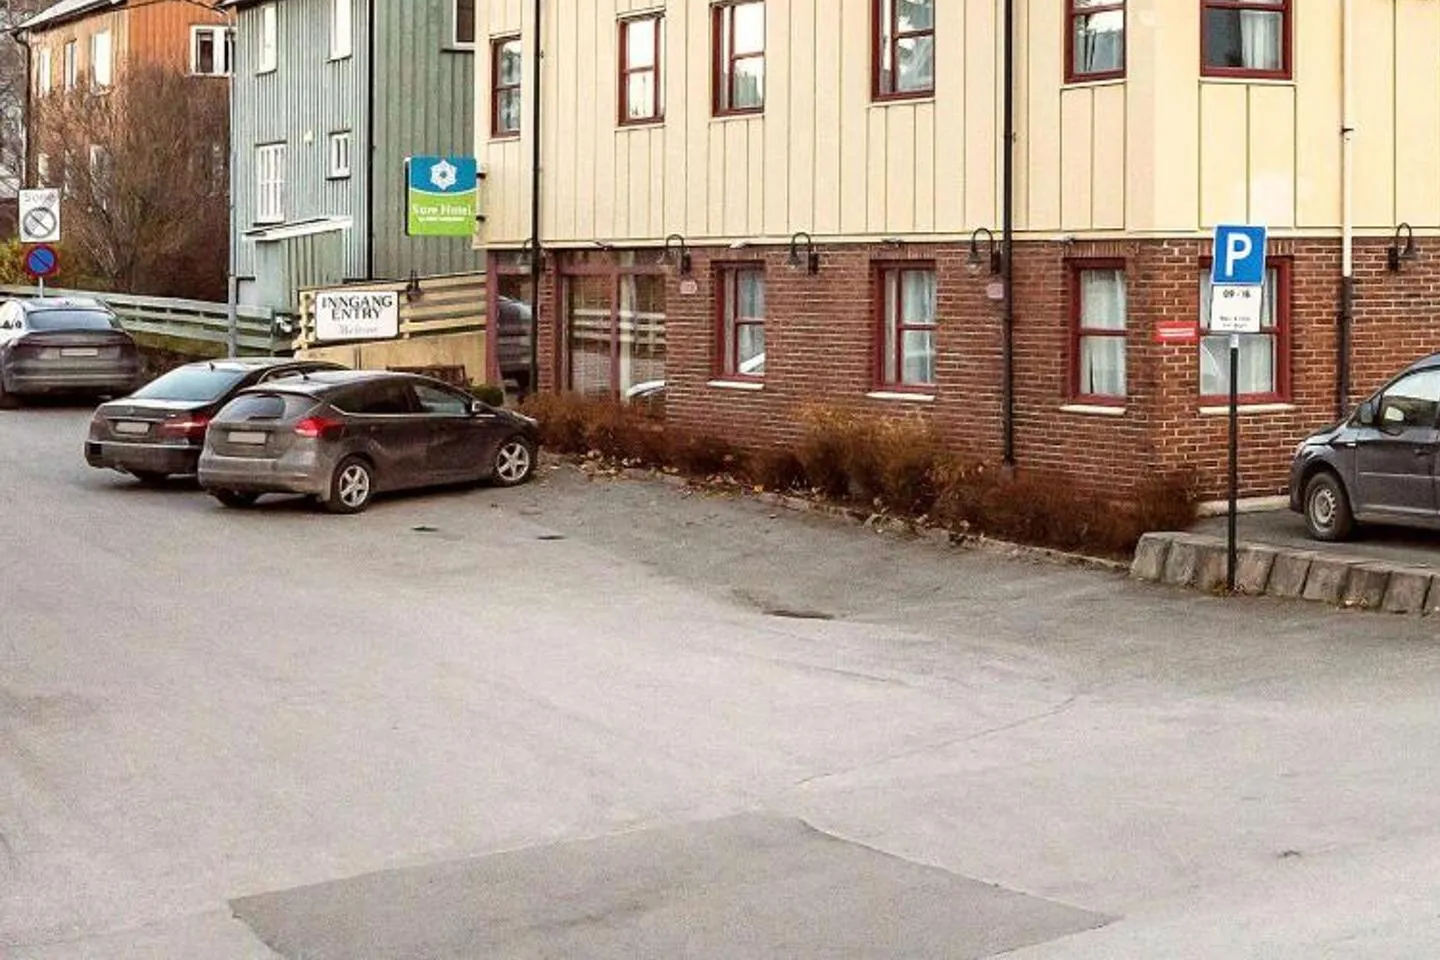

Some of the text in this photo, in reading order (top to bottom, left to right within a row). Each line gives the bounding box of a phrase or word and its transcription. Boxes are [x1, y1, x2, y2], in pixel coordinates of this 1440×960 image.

[1226, 232, 1252, 277] P
[321, 295, 393, 309] INNGANG
[331, 307, 382, 320] ENTRY
